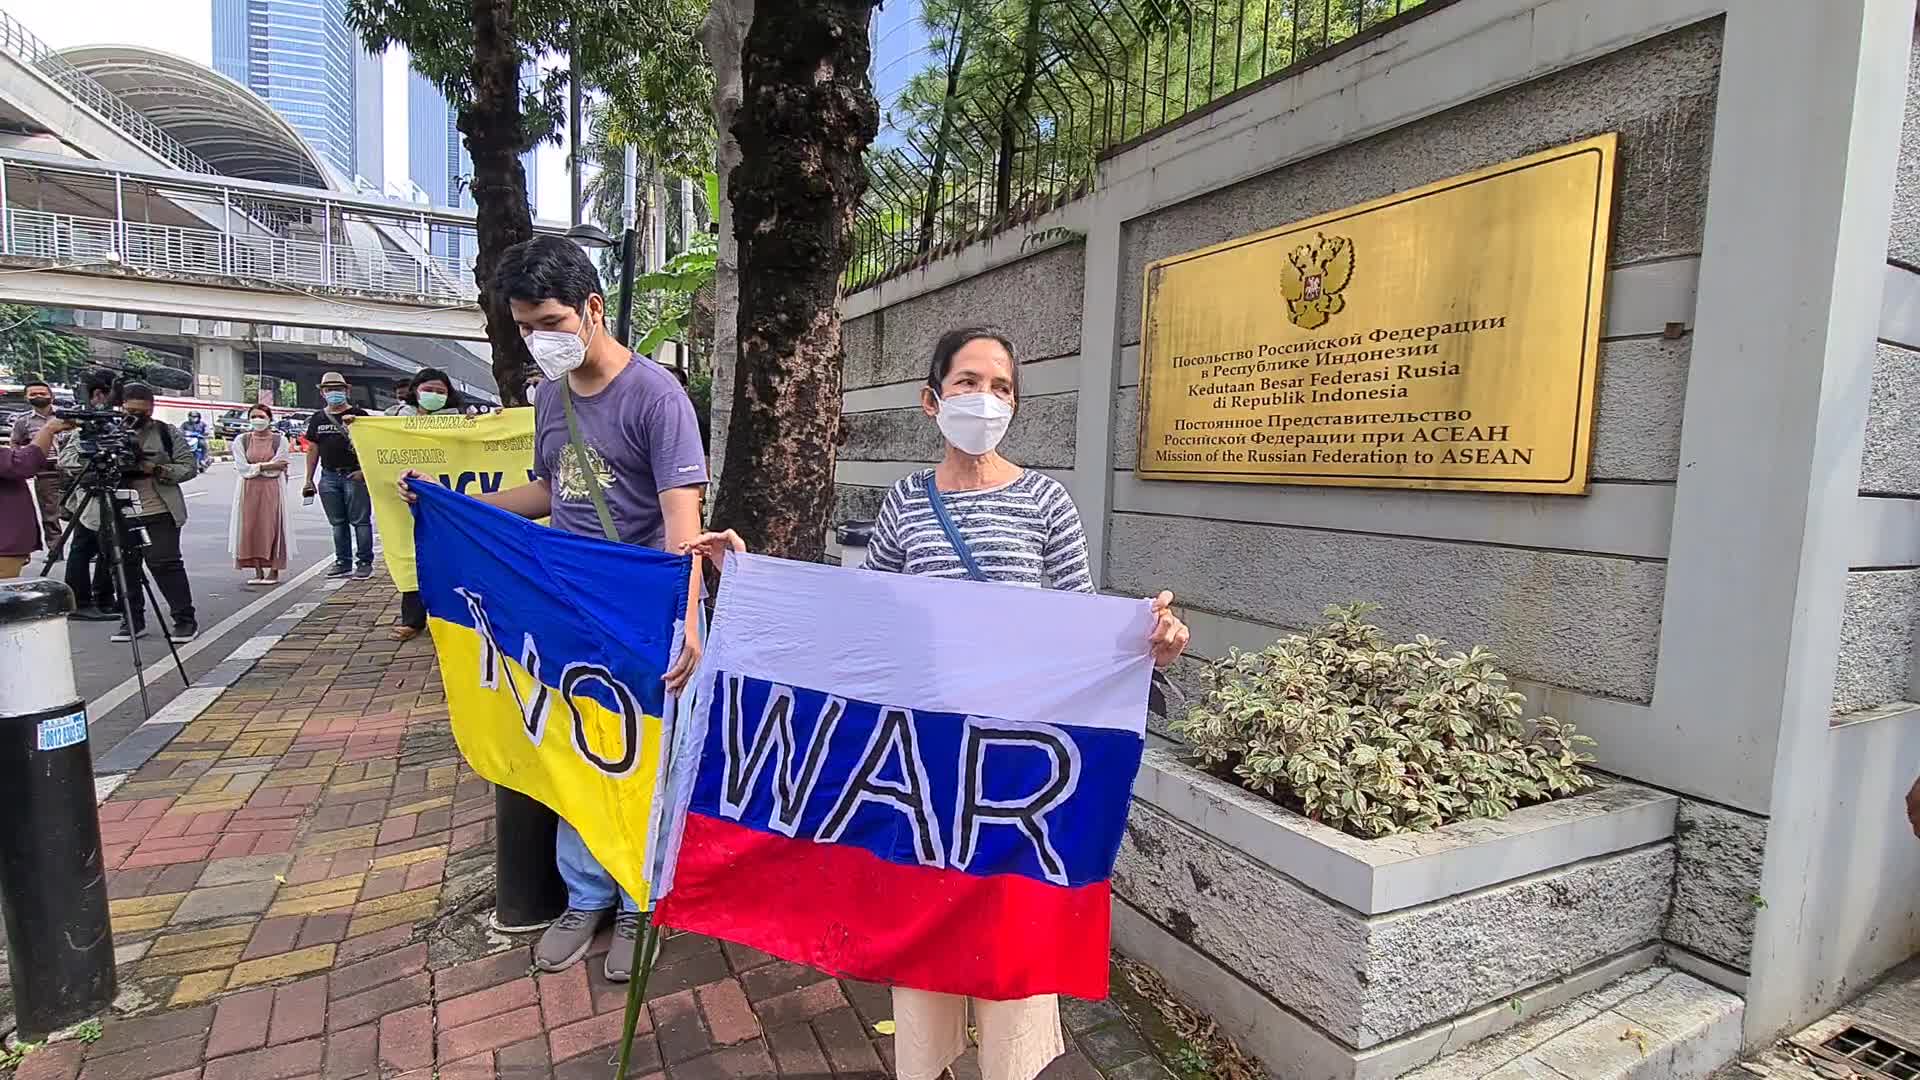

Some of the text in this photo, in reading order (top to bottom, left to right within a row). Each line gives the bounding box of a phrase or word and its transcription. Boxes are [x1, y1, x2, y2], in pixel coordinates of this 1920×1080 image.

[1172, 316, 1507, 368] Посольство Российской Федерации
[1201, 344, 1440, 378] в Республике Индонезии
[1188, 361, 1461, 397] Kedutaan Besar Federasi Rusia
[1213, 384, 1409, 410] di Republik Indonesia
[1175, 410, 1472, 431] Постоянное Представительство
[1164, 426, 1511, 447] Российской Федерации при АСЕАН
[376, 449, 447, 465] KASHMIR
[1155, 449, 1535, 465] Mission of the Russian Federation to ASEAN
[453, 587, 1082, 886] NO WAR
